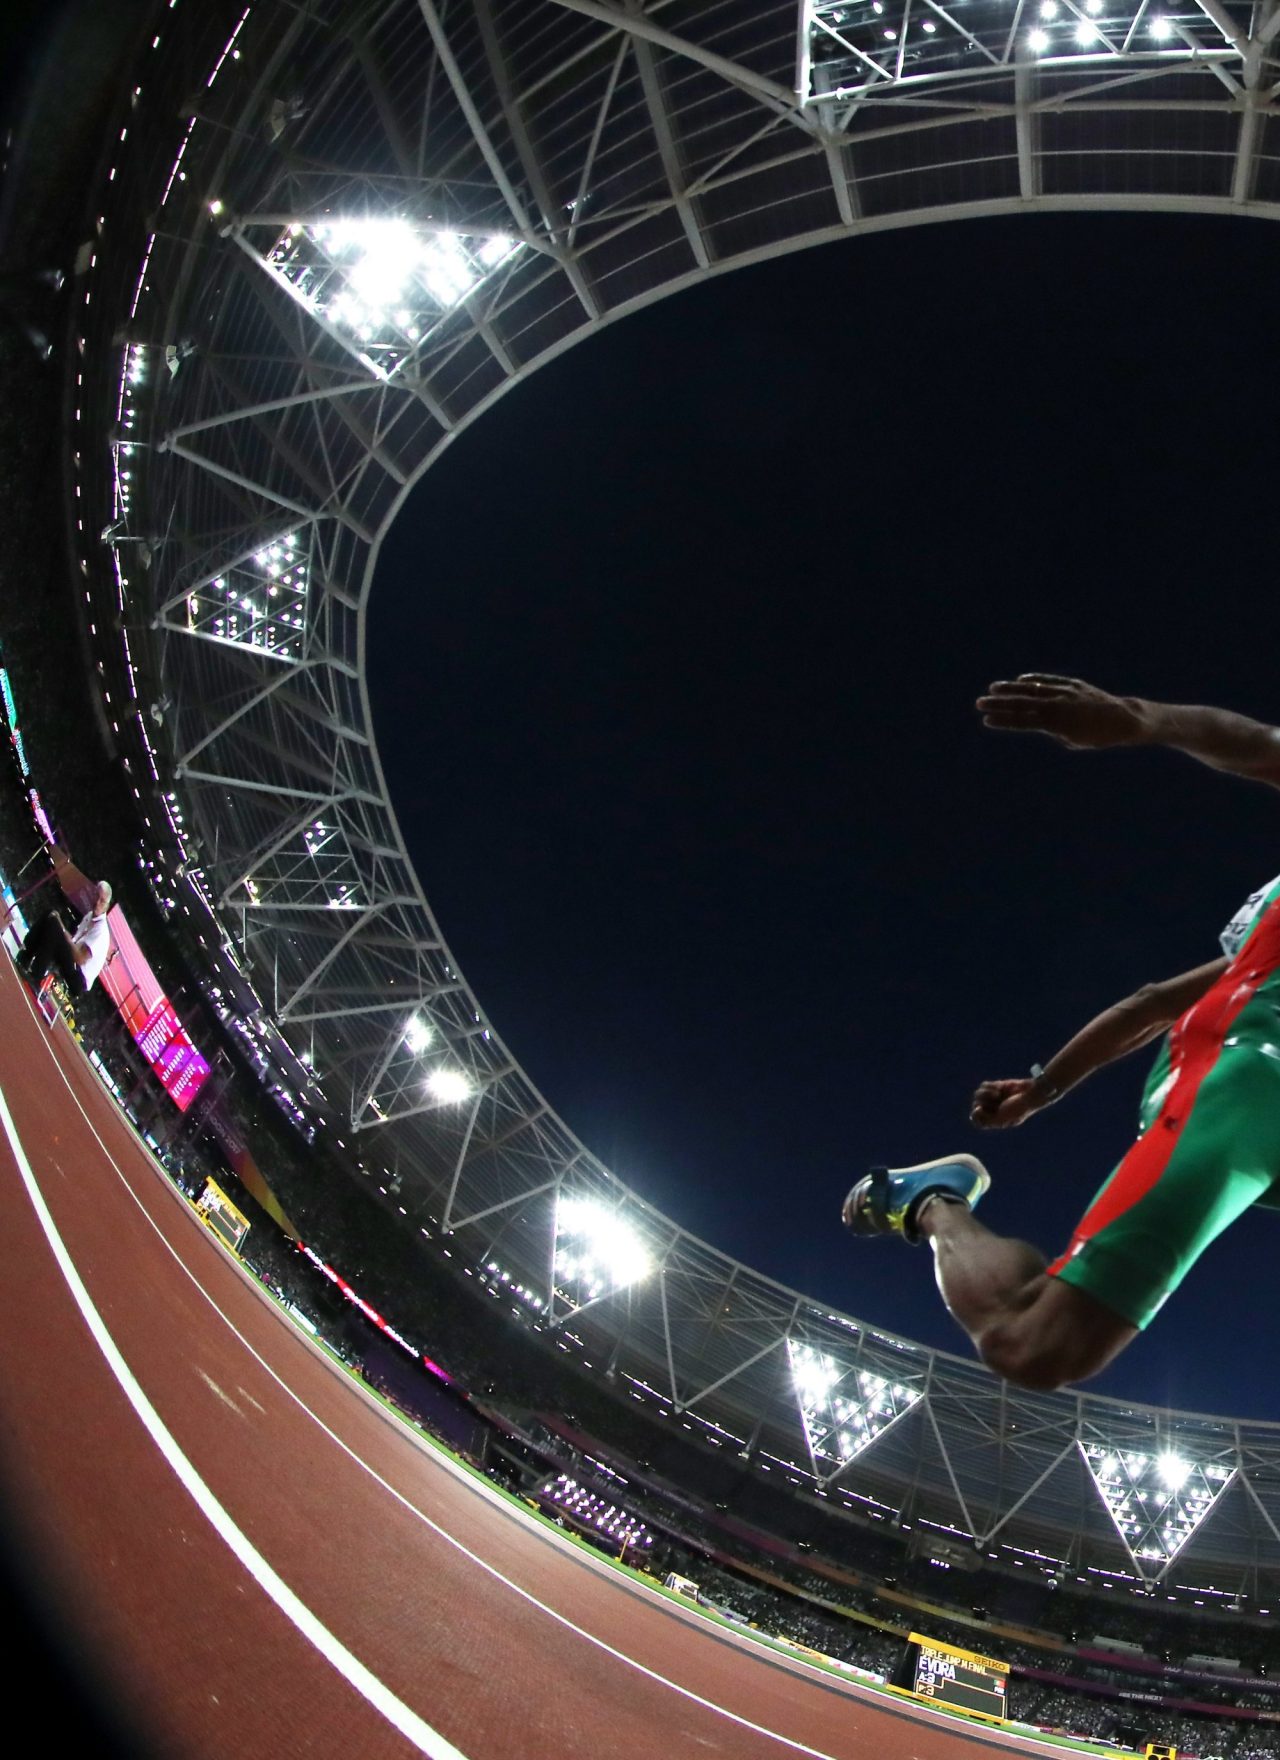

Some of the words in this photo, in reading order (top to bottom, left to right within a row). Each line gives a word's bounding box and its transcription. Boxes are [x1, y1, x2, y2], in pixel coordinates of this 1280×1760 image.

[918, 1654, 956, 1680] ÉVORA
[921, 1645, 943, 1661] TRIPLE
[944, 1654, 961, 1666] JUMP
[961, 1659, 968, 1670] M
[968, 1661, 988, 1676] FINAL
[973, 1655, 1006, 1671] SEIKO
[1246, 1677, 1278, 1687] LONDON
